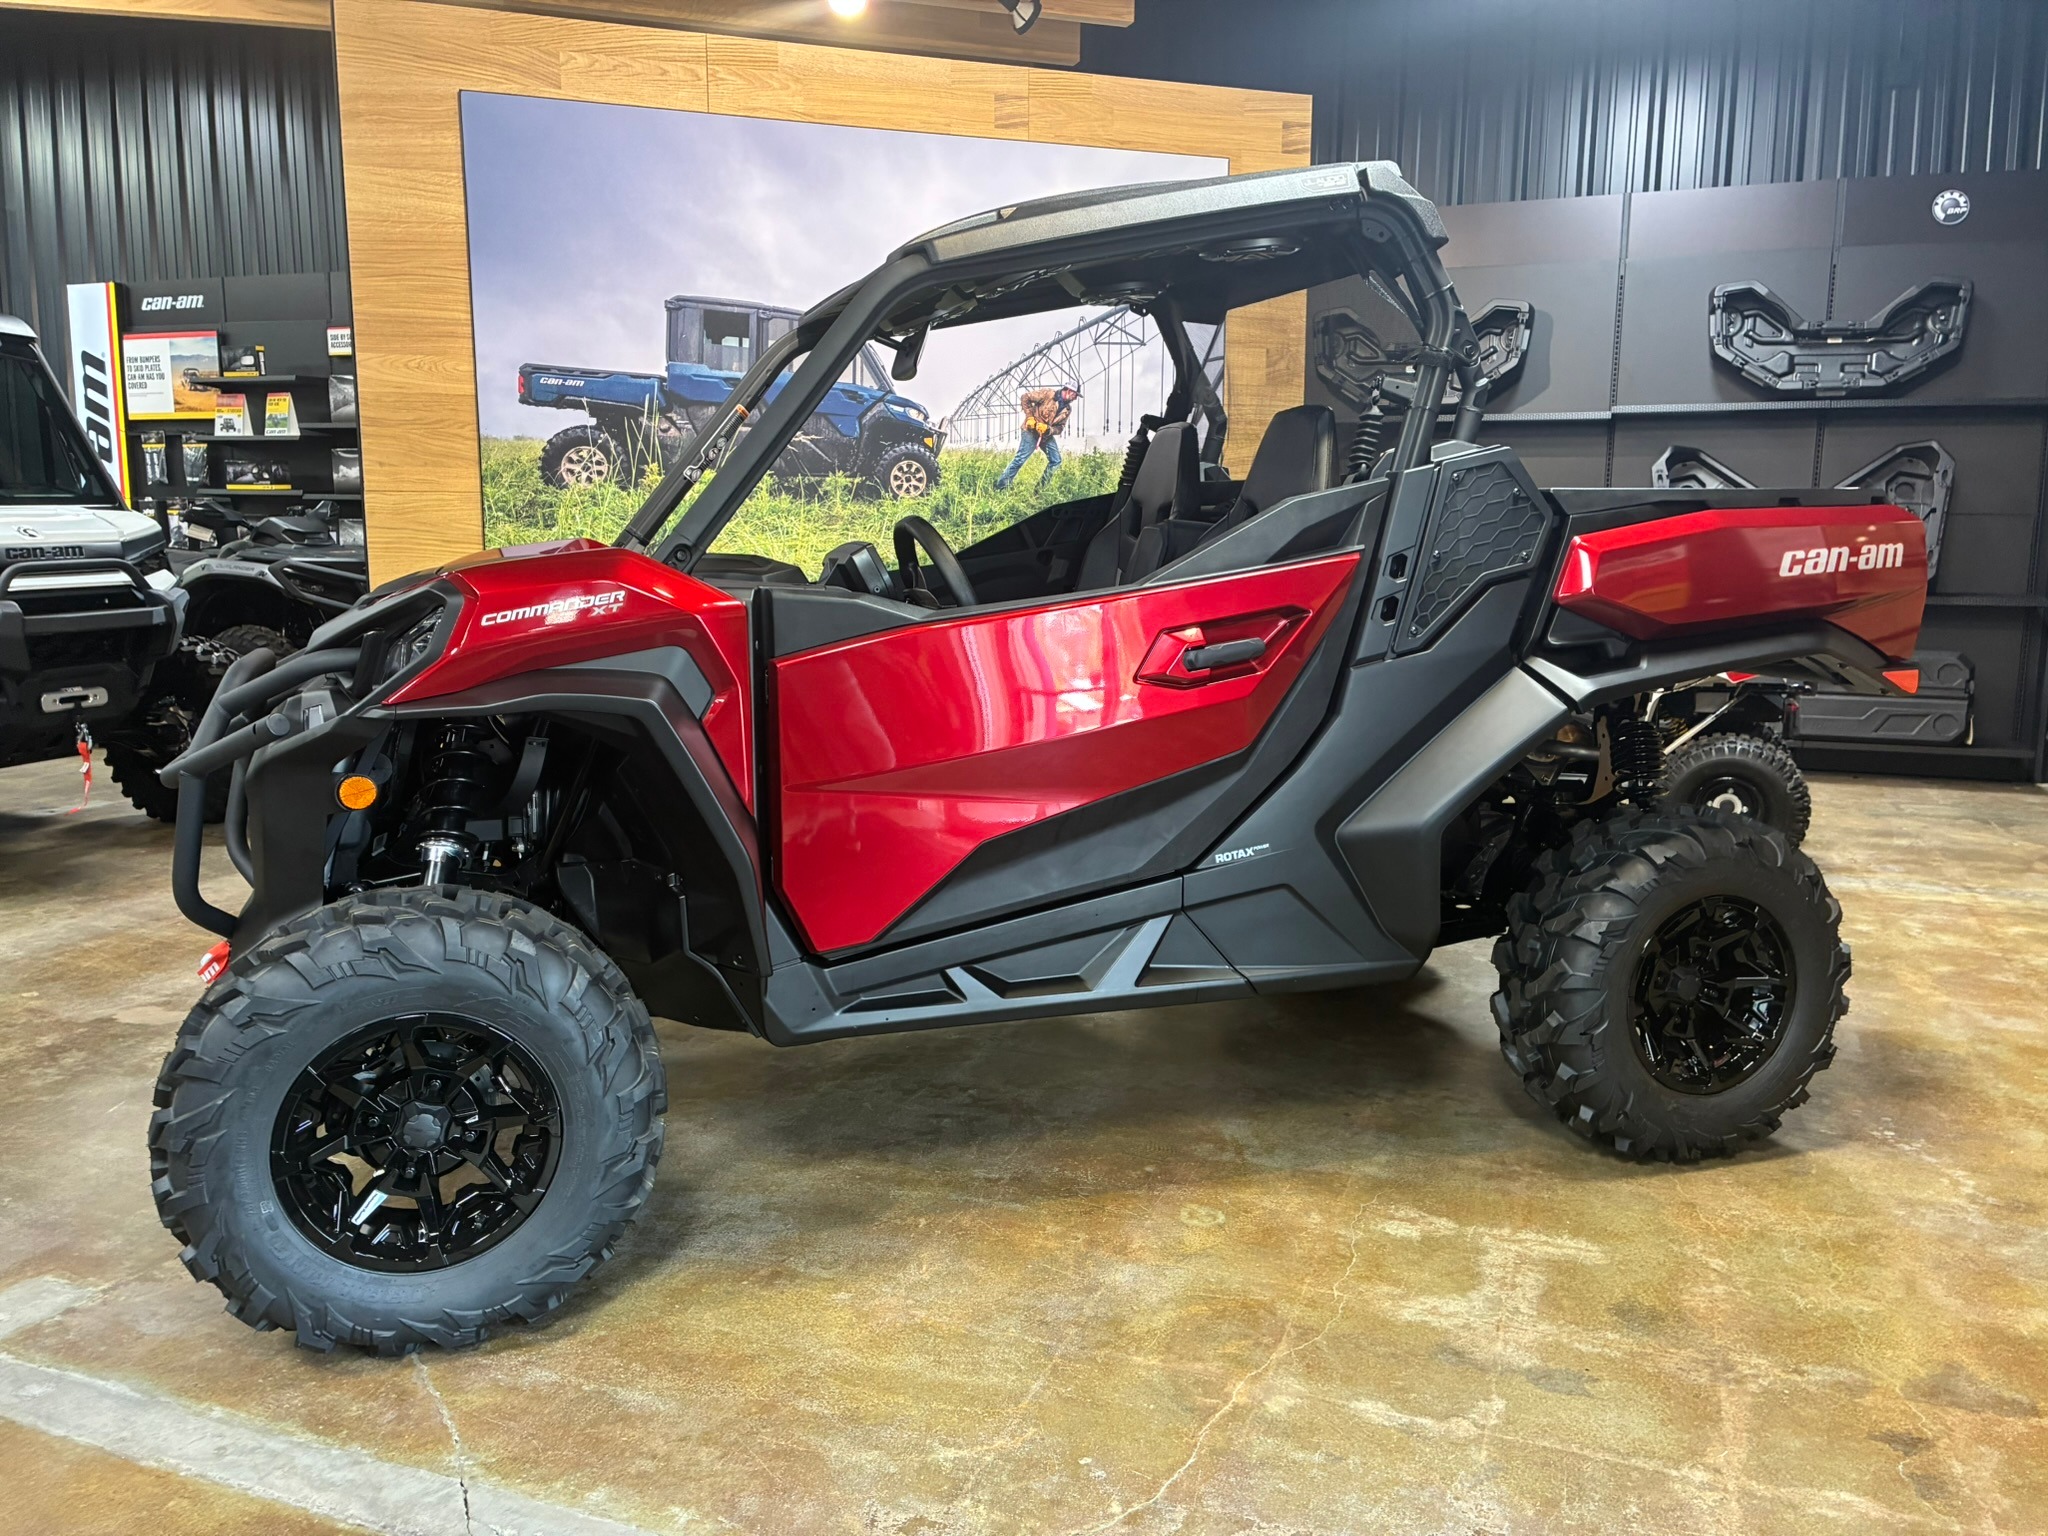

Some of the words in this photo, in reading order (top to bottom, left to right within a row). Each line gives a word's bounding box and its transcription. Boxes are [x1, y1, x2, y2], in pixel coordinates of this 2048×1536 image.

[1946, 207, 1968, 215] BRP
[141, 294, 205, 311] can-am
[126, 356, 139, 364] FROM
[139, 355, 161, 363] BUMPERS
[133, 364, 144, 372] SKID
[127, 373, 137, 381] CAN
[146, 372, 156, 380] HAS
[156, 372, 165, 380] YOU
[539, 376, 585, 387] can-am
[128, 381, 147, 389] COVERED
[5, 545, 85, 560] can-am
[1779, 542, 1904, 577] can-am
[480, 590, 627, 627] COMMANDER
[588, 602, 625, 618] XT
[1215, 847, 1254, 863] ROTAX
